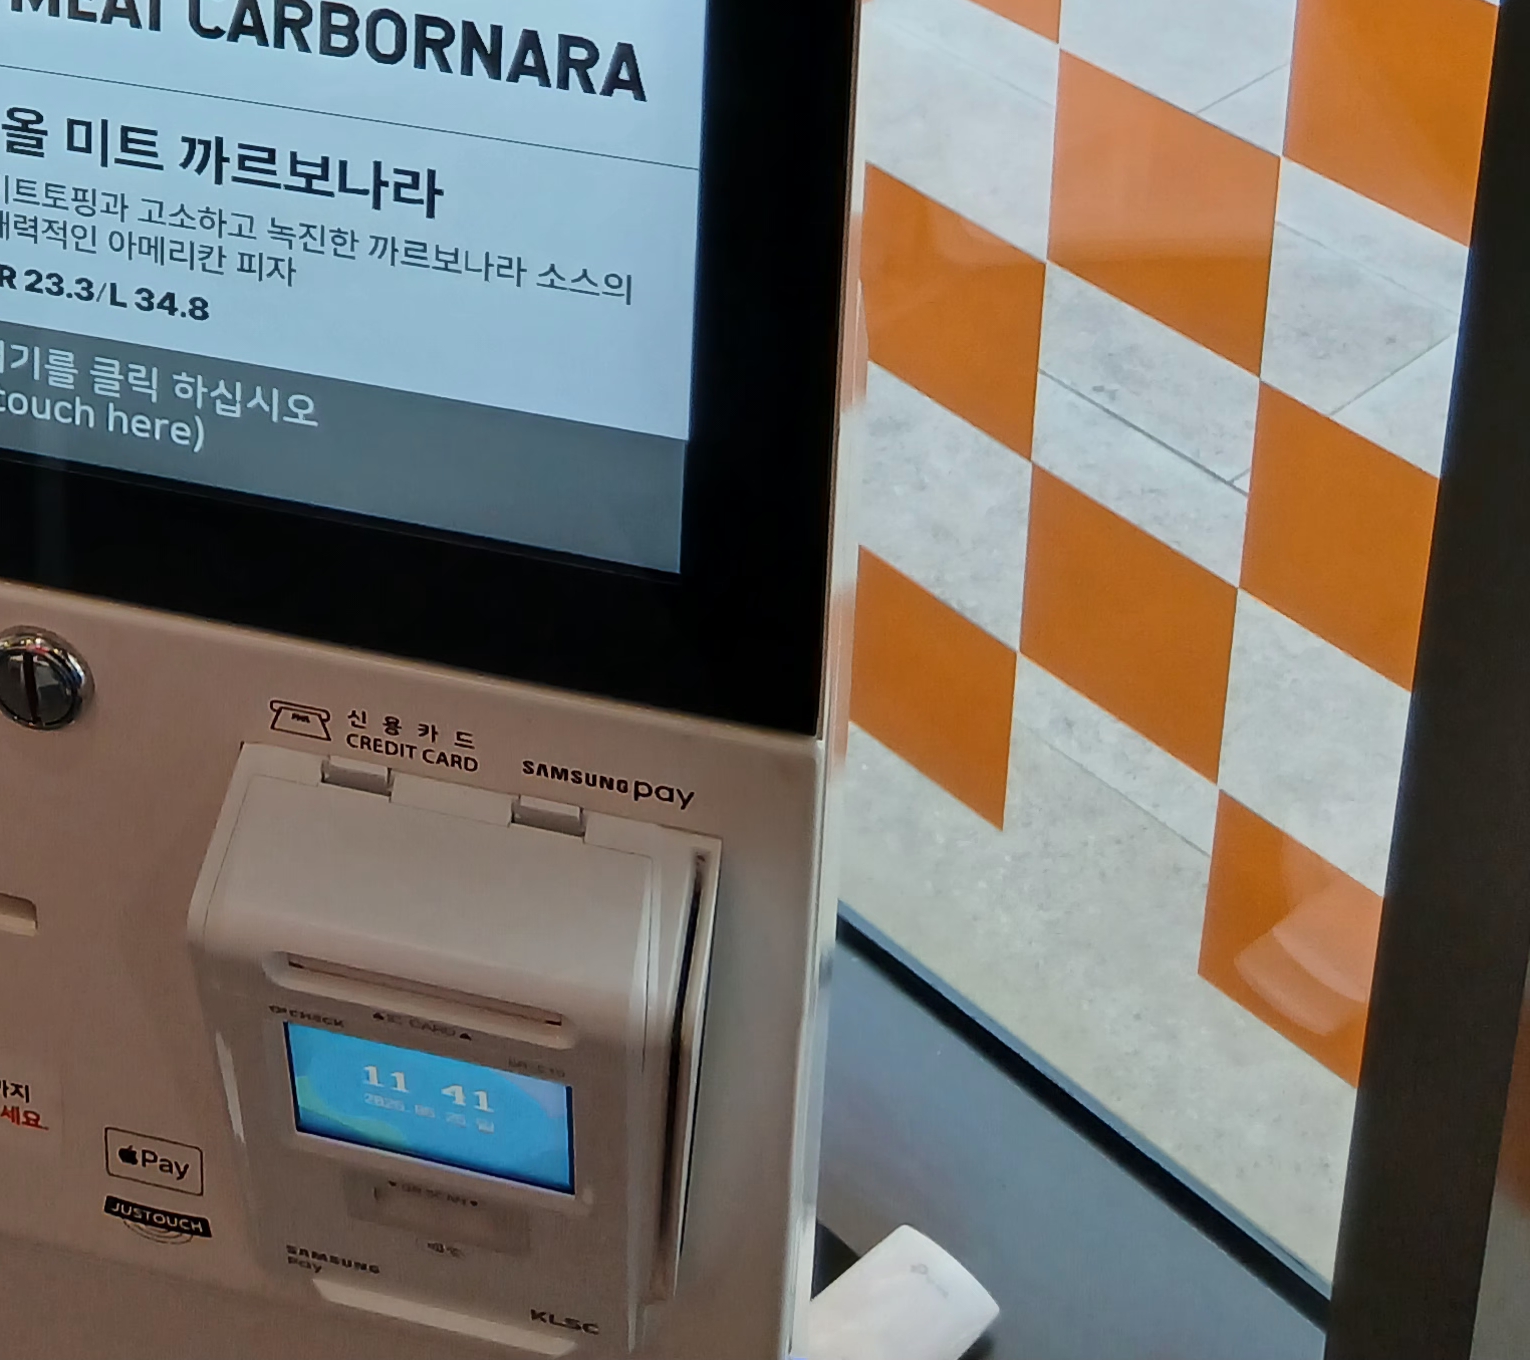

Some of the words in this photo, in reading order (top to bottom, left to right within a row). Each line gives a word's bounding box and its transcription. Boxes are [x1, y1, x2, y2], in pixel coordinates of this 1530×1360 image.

[1, 106, 49, 159] 올
[66, 117, 165, 172] 미트
[178, 133, 445, 220] 까르보나라
[108, 229, 227, 276] 아메리칸
[235, 250, 297, 288] 피자
[137, 196, 257, 240] 고소하고
[266, 216, 360, 261] 녹진한
[368, 234, 527, 288] 까르보나라
[536, 262, 633, 306] 소스의
[134, 286, 210, 322] 34.8
[89, 355, 159, 404] 클릭
[172, 369, 320, 428] 하십시오
[107, 401, 206, 453] here)
[345, 733, 418, 760] CREDIT
[421, 747, 479, 773] CARD
[521, 759, 629, 795] SAMSUNG
[633, 780, 696, 811] pay
[110, 1202, 204, 1234] JUSTOUCH
[285, 1243, 381, 1275] SAMSUNG
